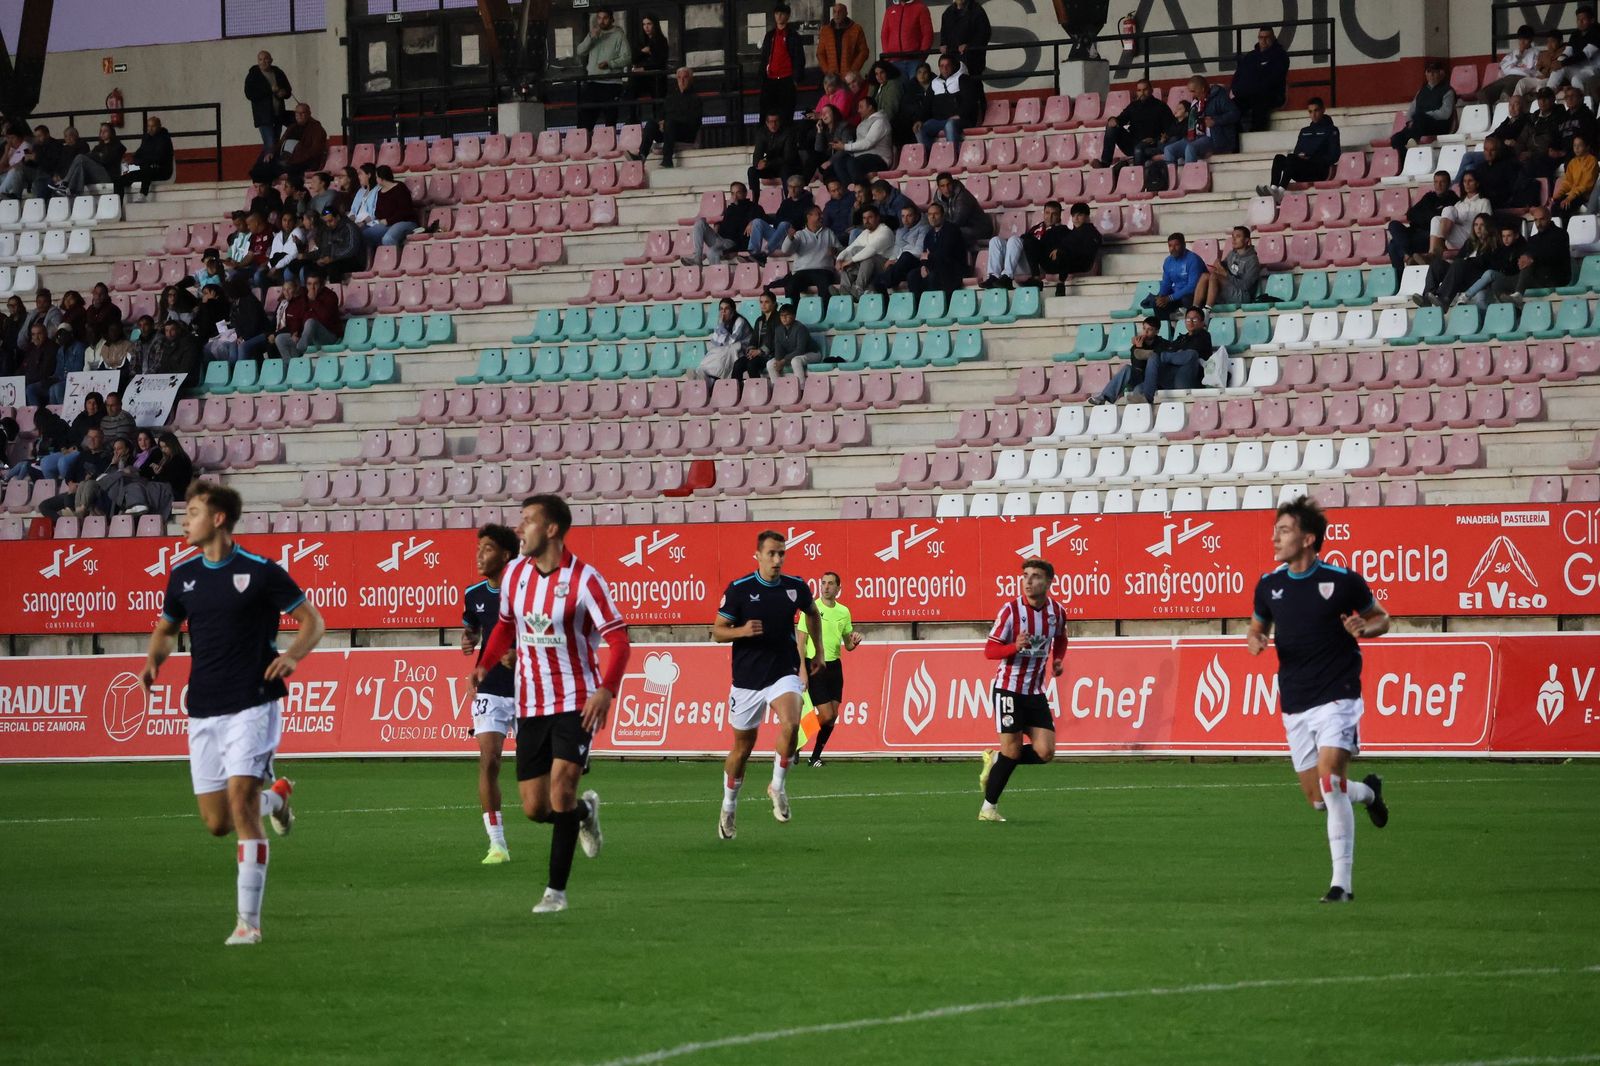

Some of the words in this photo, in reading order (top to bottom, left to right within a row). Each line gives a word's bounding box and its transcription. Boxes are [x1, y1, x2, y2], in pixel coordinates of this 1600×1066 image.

[1324, 524, 1350, 540] CES
[804, 542, 821, 561] sgc
[927, 540, 945, 558] sgc
[1070, 537, 1089, 555] sgc
[1202, 535, 1221, 552] sgc
[313, 553, 329, 571] sgc
[424, 551, 439, 569] sgc
[669, 545, 686, 563] sgc
[83, 558, 98, 576] sgc
[1351, 545, 1448, 582] recicla
[609, 574, 705, 609] angregorio
[855, 569, 966, 605] sangregorio
[1124, 568, 1244, 603] sangregorio
[23, 585, 117, 618] sangregorio
[359, 579, 458, 613] sangregorio
[1001, 696, 1014, 713] 19
[1071, 676, 1155, 728] Chef
[1376, 672, 1466, 727] Chef
[619, 694, 665, 728] Susi
[33, 722, 45, 732] DE
[47, 721, 86, 732] ZAMORA
